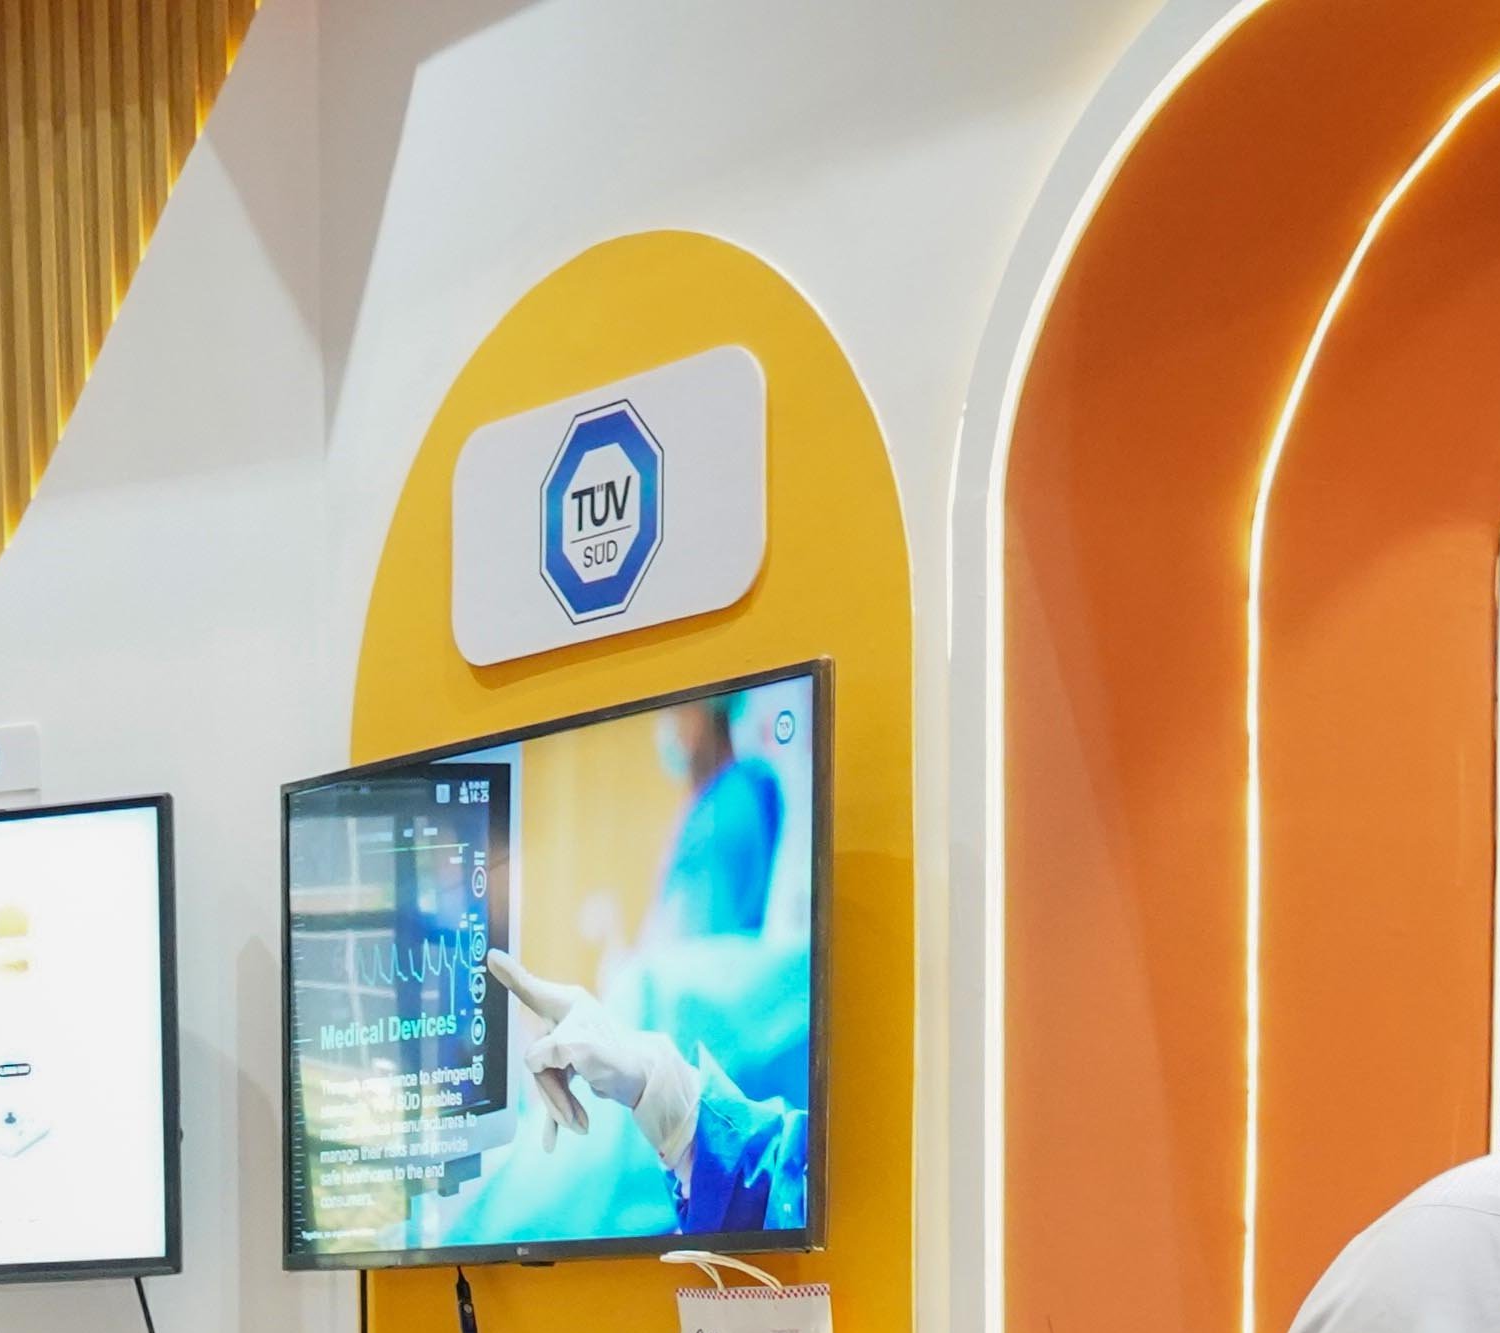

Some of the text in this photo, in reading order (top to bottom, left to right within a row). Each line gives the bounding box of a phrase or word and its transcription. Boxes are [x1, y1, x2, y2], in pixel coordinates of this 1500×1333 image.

[571, 475, 632, 532] TÜV
[583, 539, 618, 568] SÜD
[320, 1013, 457, 1051] Medical Devices
